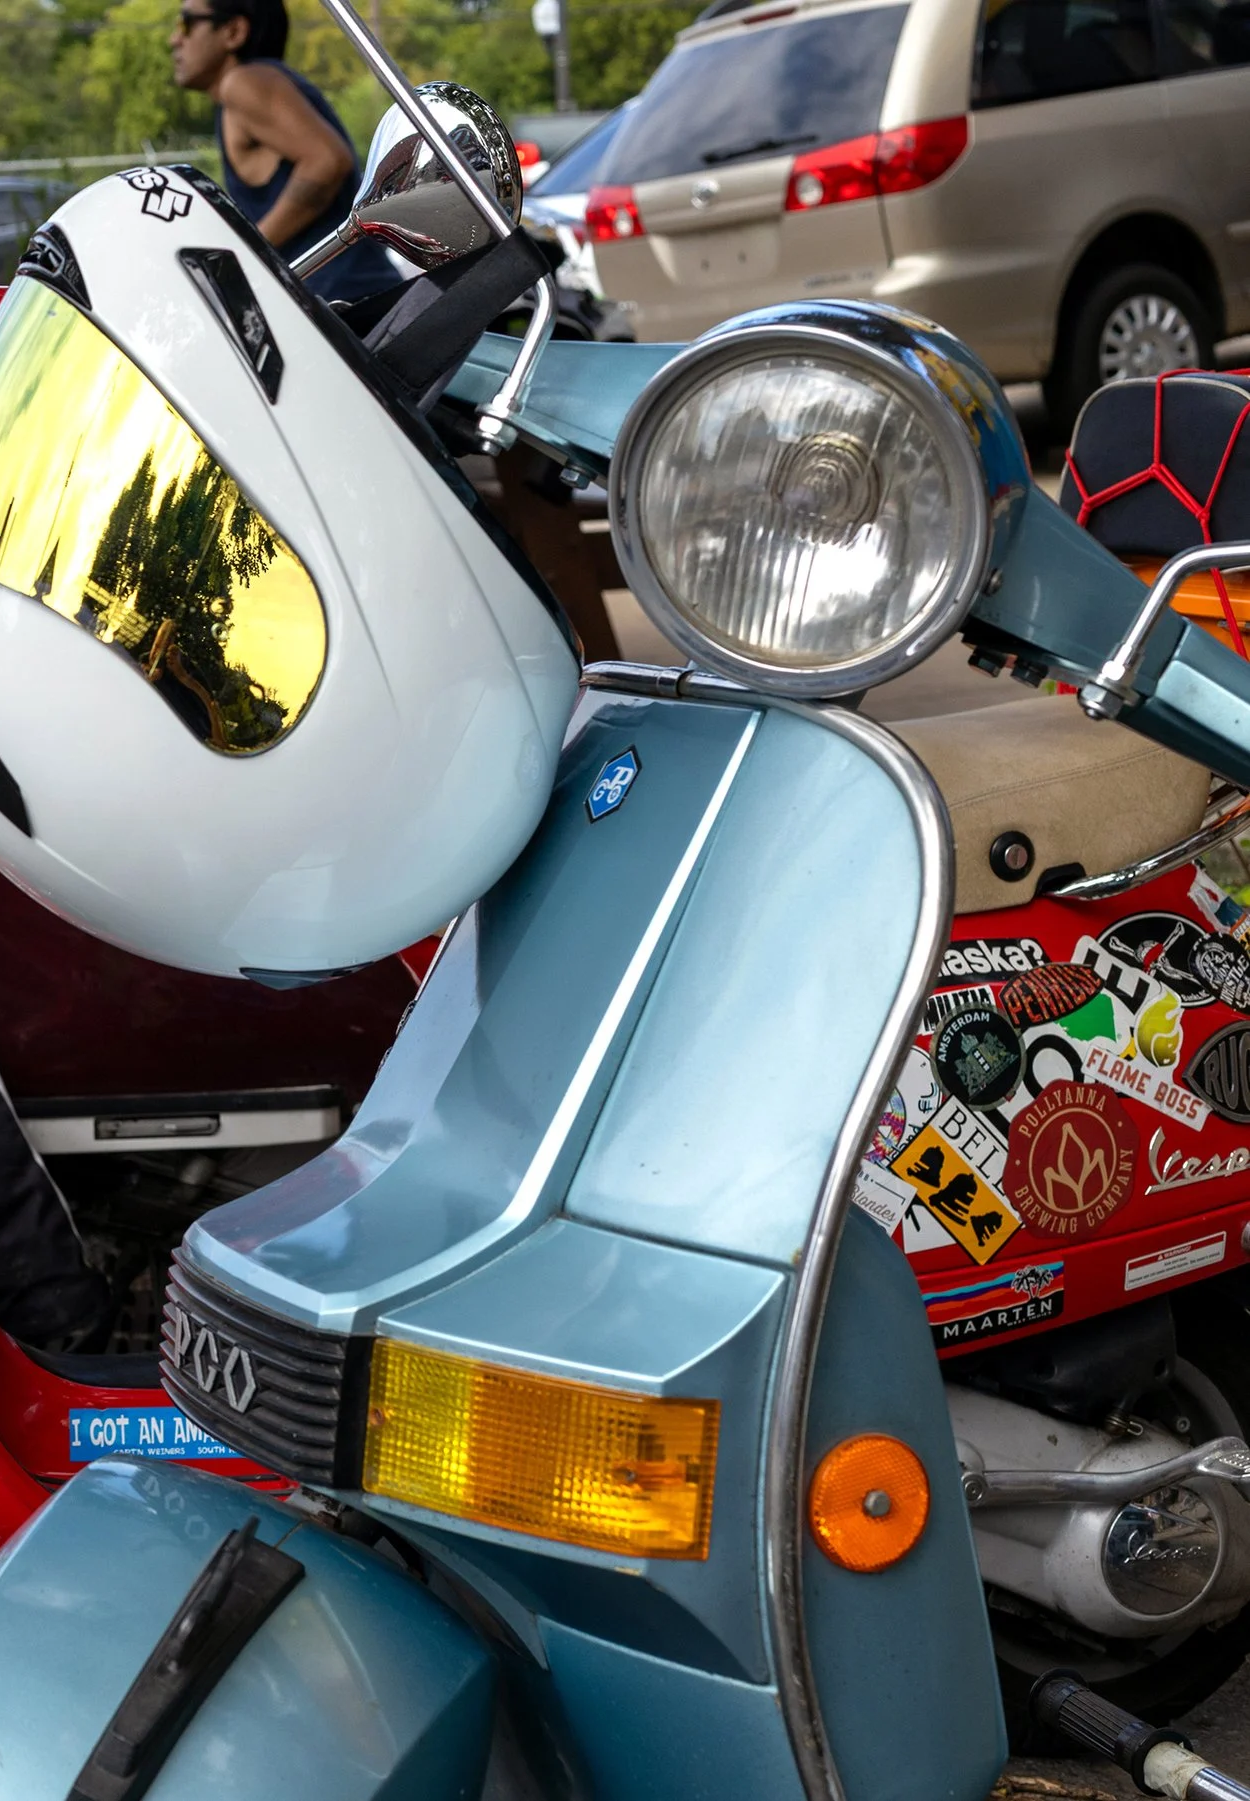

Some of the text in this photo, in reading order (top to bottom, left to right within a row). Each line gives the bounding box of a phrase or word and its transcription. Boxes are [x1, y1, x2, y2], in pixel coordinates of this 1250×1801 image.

[938, 939, 1046, 977] aska?
[937, 1011, 991, 1063] AMSTERDAM
[1086, 1048, 1204, 1121] FLAME BOSS
[1018, 1086, 1107, 1139] POLLYANNA
[1014, 1149, 1134, 1235] BREWING COMPANY
[943, 1298, 1053, 1340] MAARTEN
[173, 1305, 257, 1414] PGO
[71, 1417, 82, 1447] I
[89, 1414, 130, 1448] GOT
[138, 1416, 165, 1445] AN
[197, 1446, 226, 1455] SOUTH
